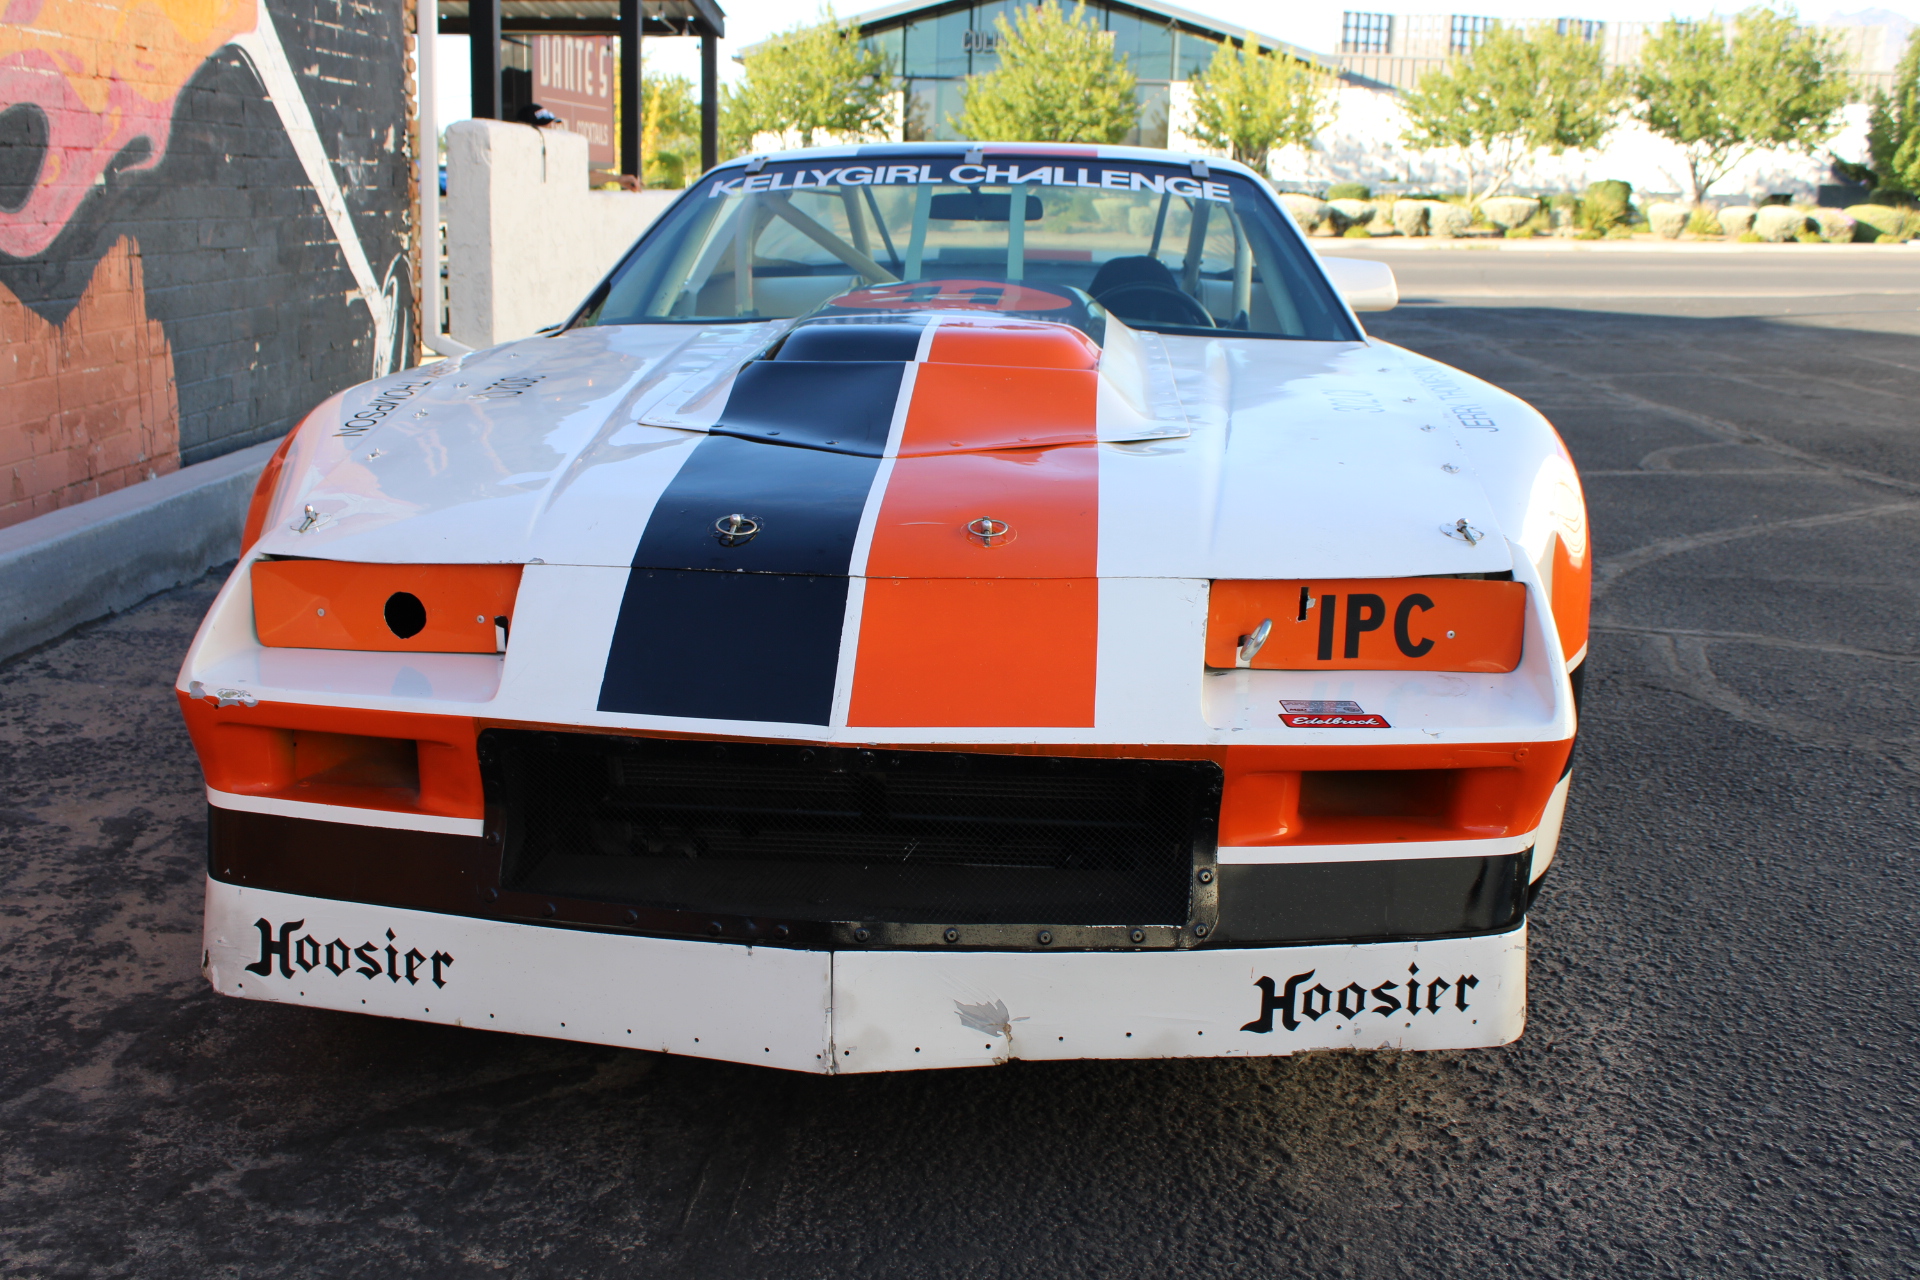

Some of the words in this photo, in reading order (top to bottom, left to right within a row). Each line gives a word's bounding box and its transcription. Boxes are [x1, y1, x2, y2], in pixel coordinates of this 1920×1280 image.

[708, 165, 943, 199] KELLYGIRL
[949, 164, 1231, 203] CHALLENGE
[895, 286, 1005, 306] 11
[332, 380, 432, 438] THOMPSON
[1446, 403, 1499, 432] JERRY
[1317, 593, 1436, 661] IPC
[1292, 716, 1380, 726] Edelbrock
[245, 917, 455, 989] Hoosier
[1239, 961, 1480, 1034] Hoosier
